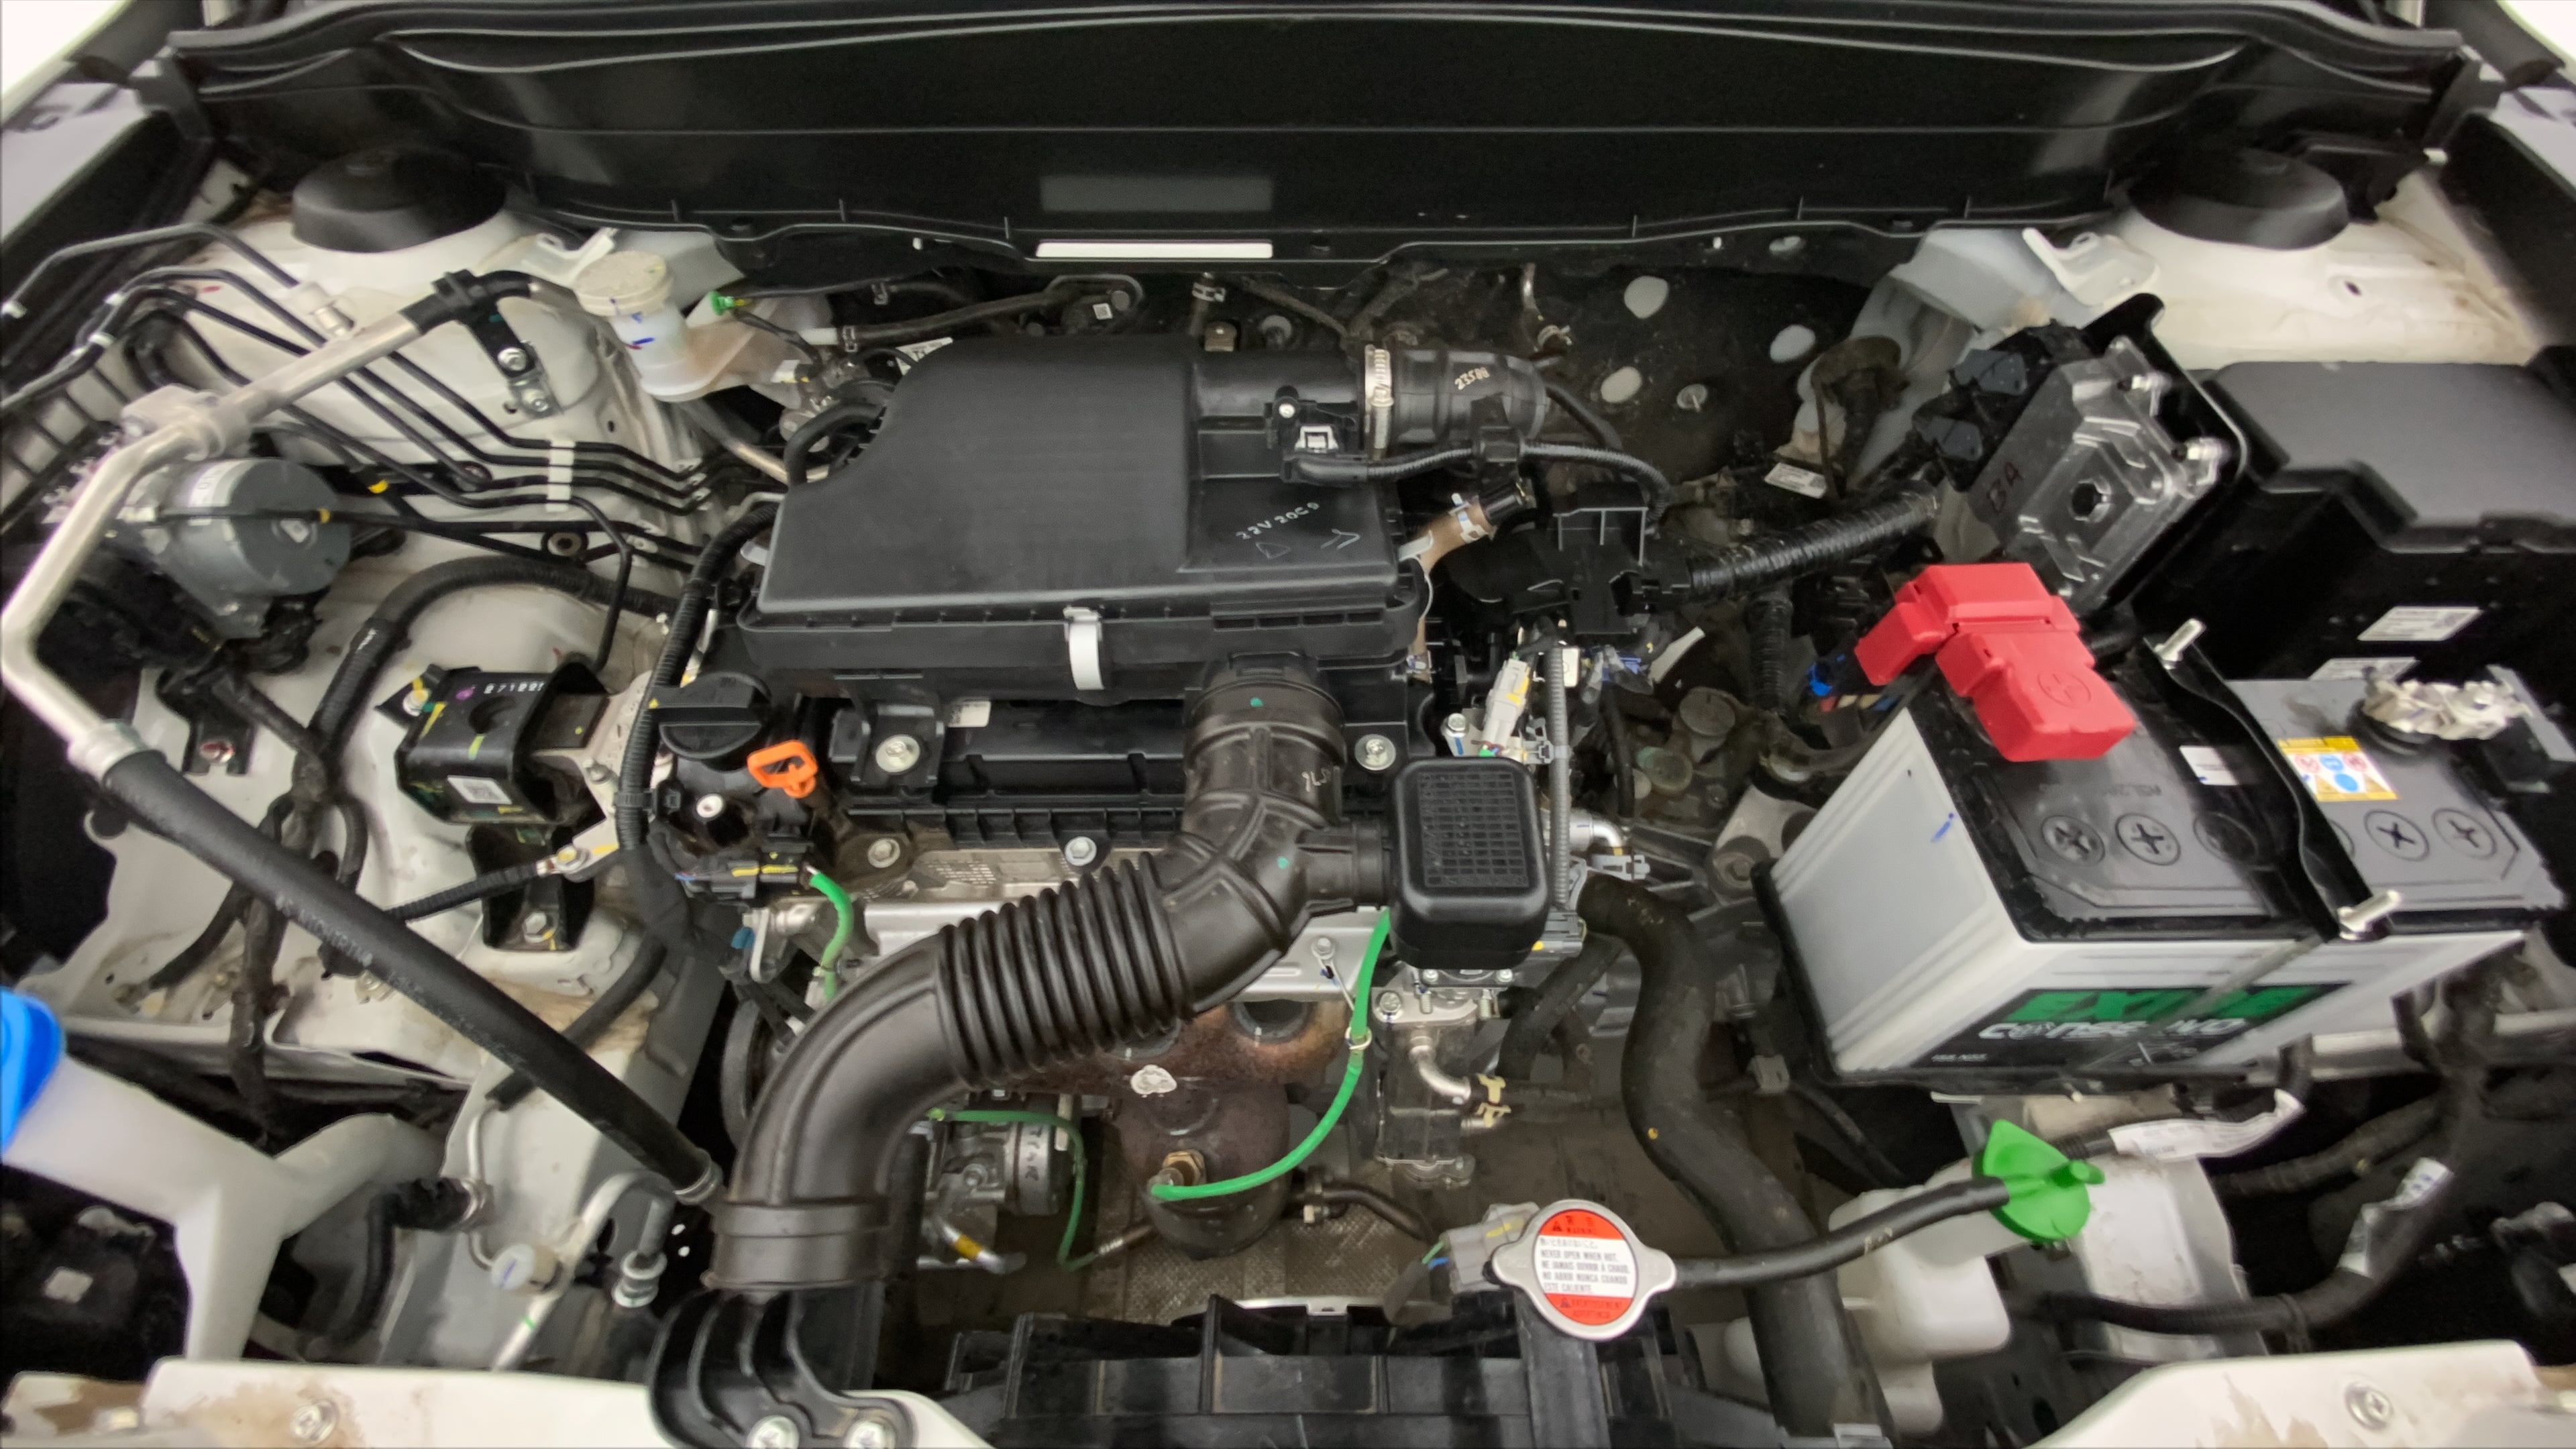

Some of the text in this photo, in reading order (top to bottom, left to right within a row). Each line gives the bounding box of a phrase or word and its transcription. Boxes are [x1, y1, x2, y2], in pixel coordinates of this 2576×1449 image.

[1541, 1250, 1561, 1258] NEVER
[1564, 1251, 1580, 1259] OPEN
[1583, 1252, 1601, 1260] WHEN
